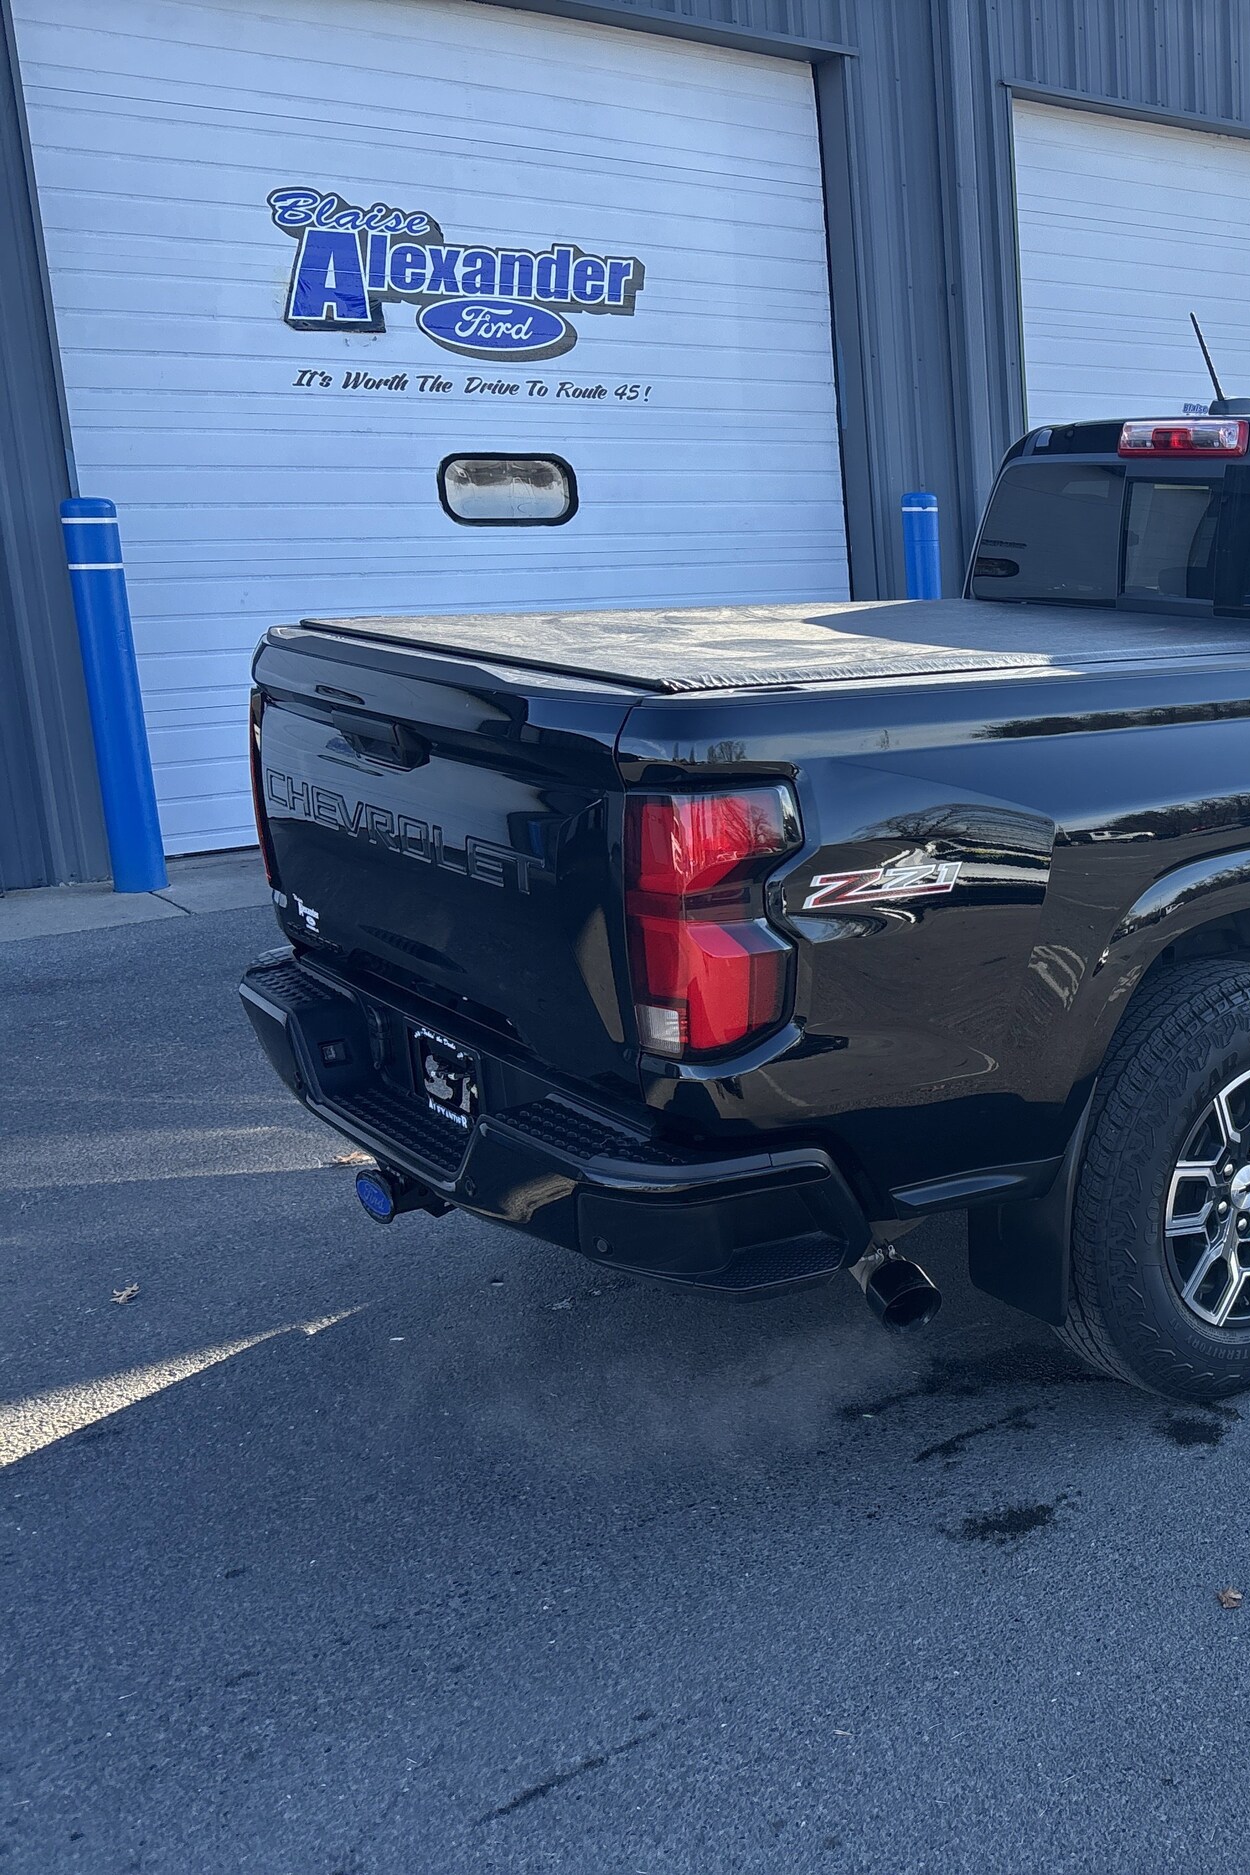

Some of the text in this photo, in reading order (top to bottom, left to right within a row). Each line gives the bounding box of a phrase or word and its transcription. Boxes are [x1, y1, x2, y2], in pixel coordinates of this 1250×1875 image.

[271, 189, 430, 236] Blaise
[288, 226, 634, 322] Alexander
[454, 305, 533, 340] Ford
[292, 369, 333, 388] It's
[341, 371, 409, 391] Worth
[416, 374, 453, 393] The
[463, 376, 520, 396] Drive
[525, 380, 549, 397] To
[556, 381, 608, 400] Route
[266, 767, 545, 895] CHEVROLET
[802, 861, 963, 910] Z71
